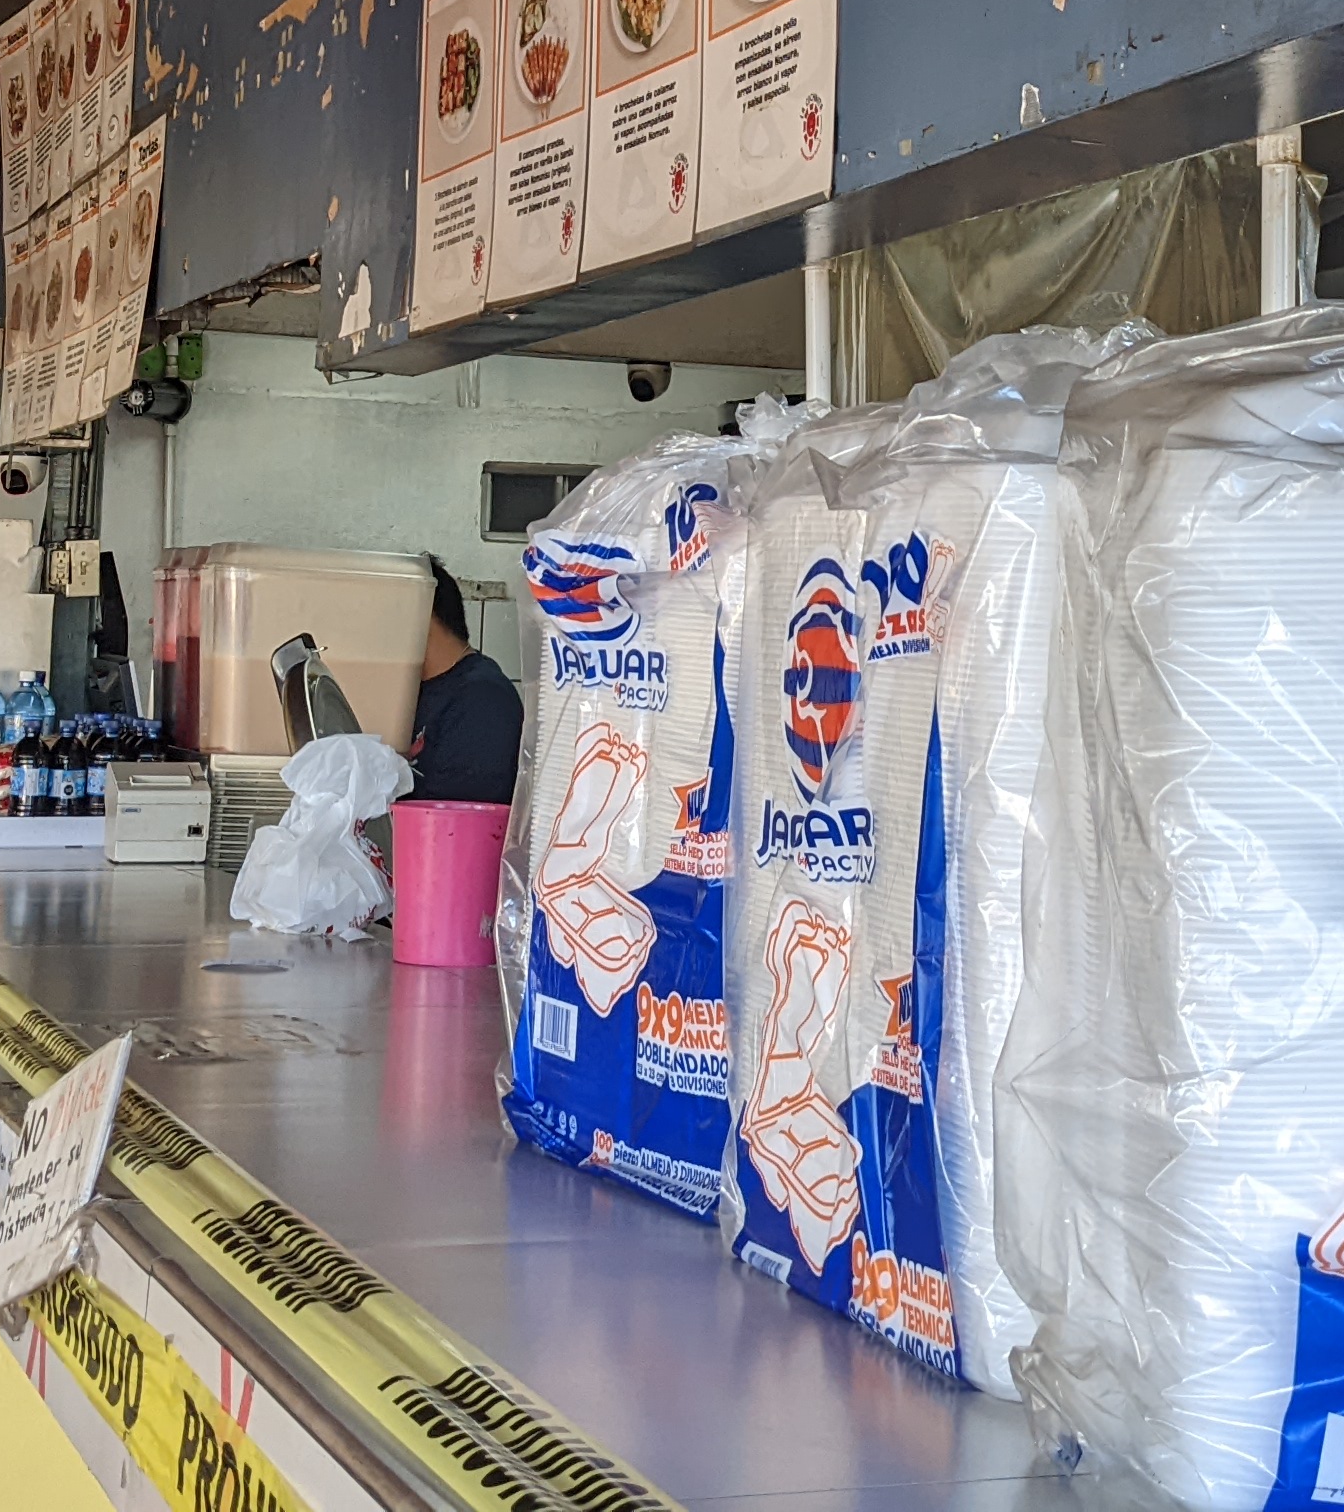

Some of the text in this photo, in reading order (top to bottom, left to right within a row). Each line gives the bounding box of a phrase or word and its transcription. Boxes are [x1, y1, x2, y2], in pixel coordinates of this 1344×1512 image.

[744, 29, 772, 48] brochetas
[735, 73, 746, 82] con
[747, 61, 773, 77] ensalada
[875, 607, 927, 639] ezas
[868, 639, 902, 661] MEJA
[757, 798, 873, 857] JAAR
[637, 984, 726, 1046] 9x9 AEJA
[637, 1038, 729, 1078] DOBLE NDADO
[677, 1075, 727, 1095] DIVISIONES
[18, 1107, 48, 1160] NO
[595, 1130, 613, 1150] 100
[613, 1142, 640, 1167] piezas
[640, 1148, 671, 1177] ALMEJA
[672, 1162, 679, 1179] 3
[679, 1164, 721, 1191] DIVISIONE
[899, 1262, 952, 1314] ALMEJA
[900, 1302, 954, 1349] TERMICA
[39, 1271, 144, 1430] OHIBIDO
